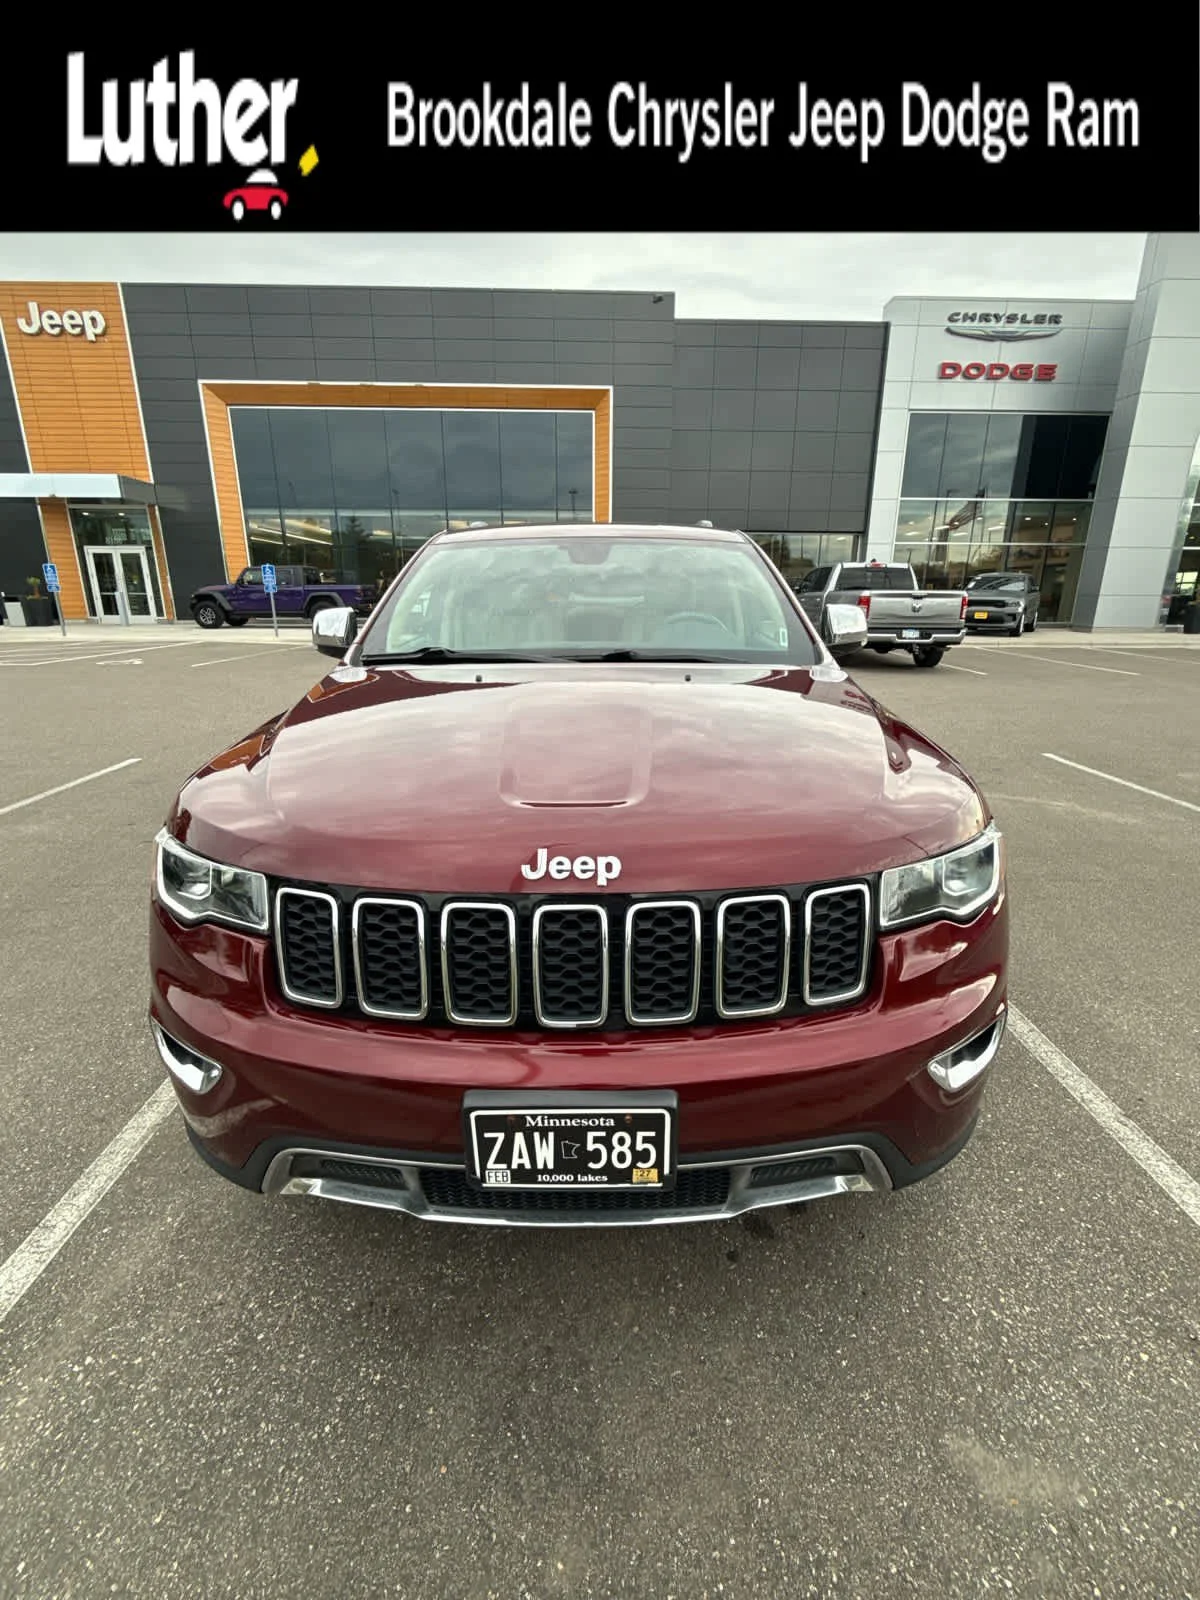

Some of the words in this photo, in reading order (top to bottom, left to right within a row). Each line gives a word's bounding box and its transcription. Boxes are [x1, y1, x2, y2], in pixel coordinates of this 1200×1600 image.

[17, 301, 106, 343] Jeep
[947, 311, 1063, 325] CHRYSLER
[938, 362, 1058, 381] DODGE
[521, 848, 622, 886] Jeep
[525, 1115, 615, 1127] Minnesota
[483, 1131, 555, 1170] ZAW
[586, 1131, 657, 1170] 585
[487, 1171, 509, 1183] FEB
[536, 1173, 574, 1184] 10,000
[577, 1173, 608, 1183] lakes
